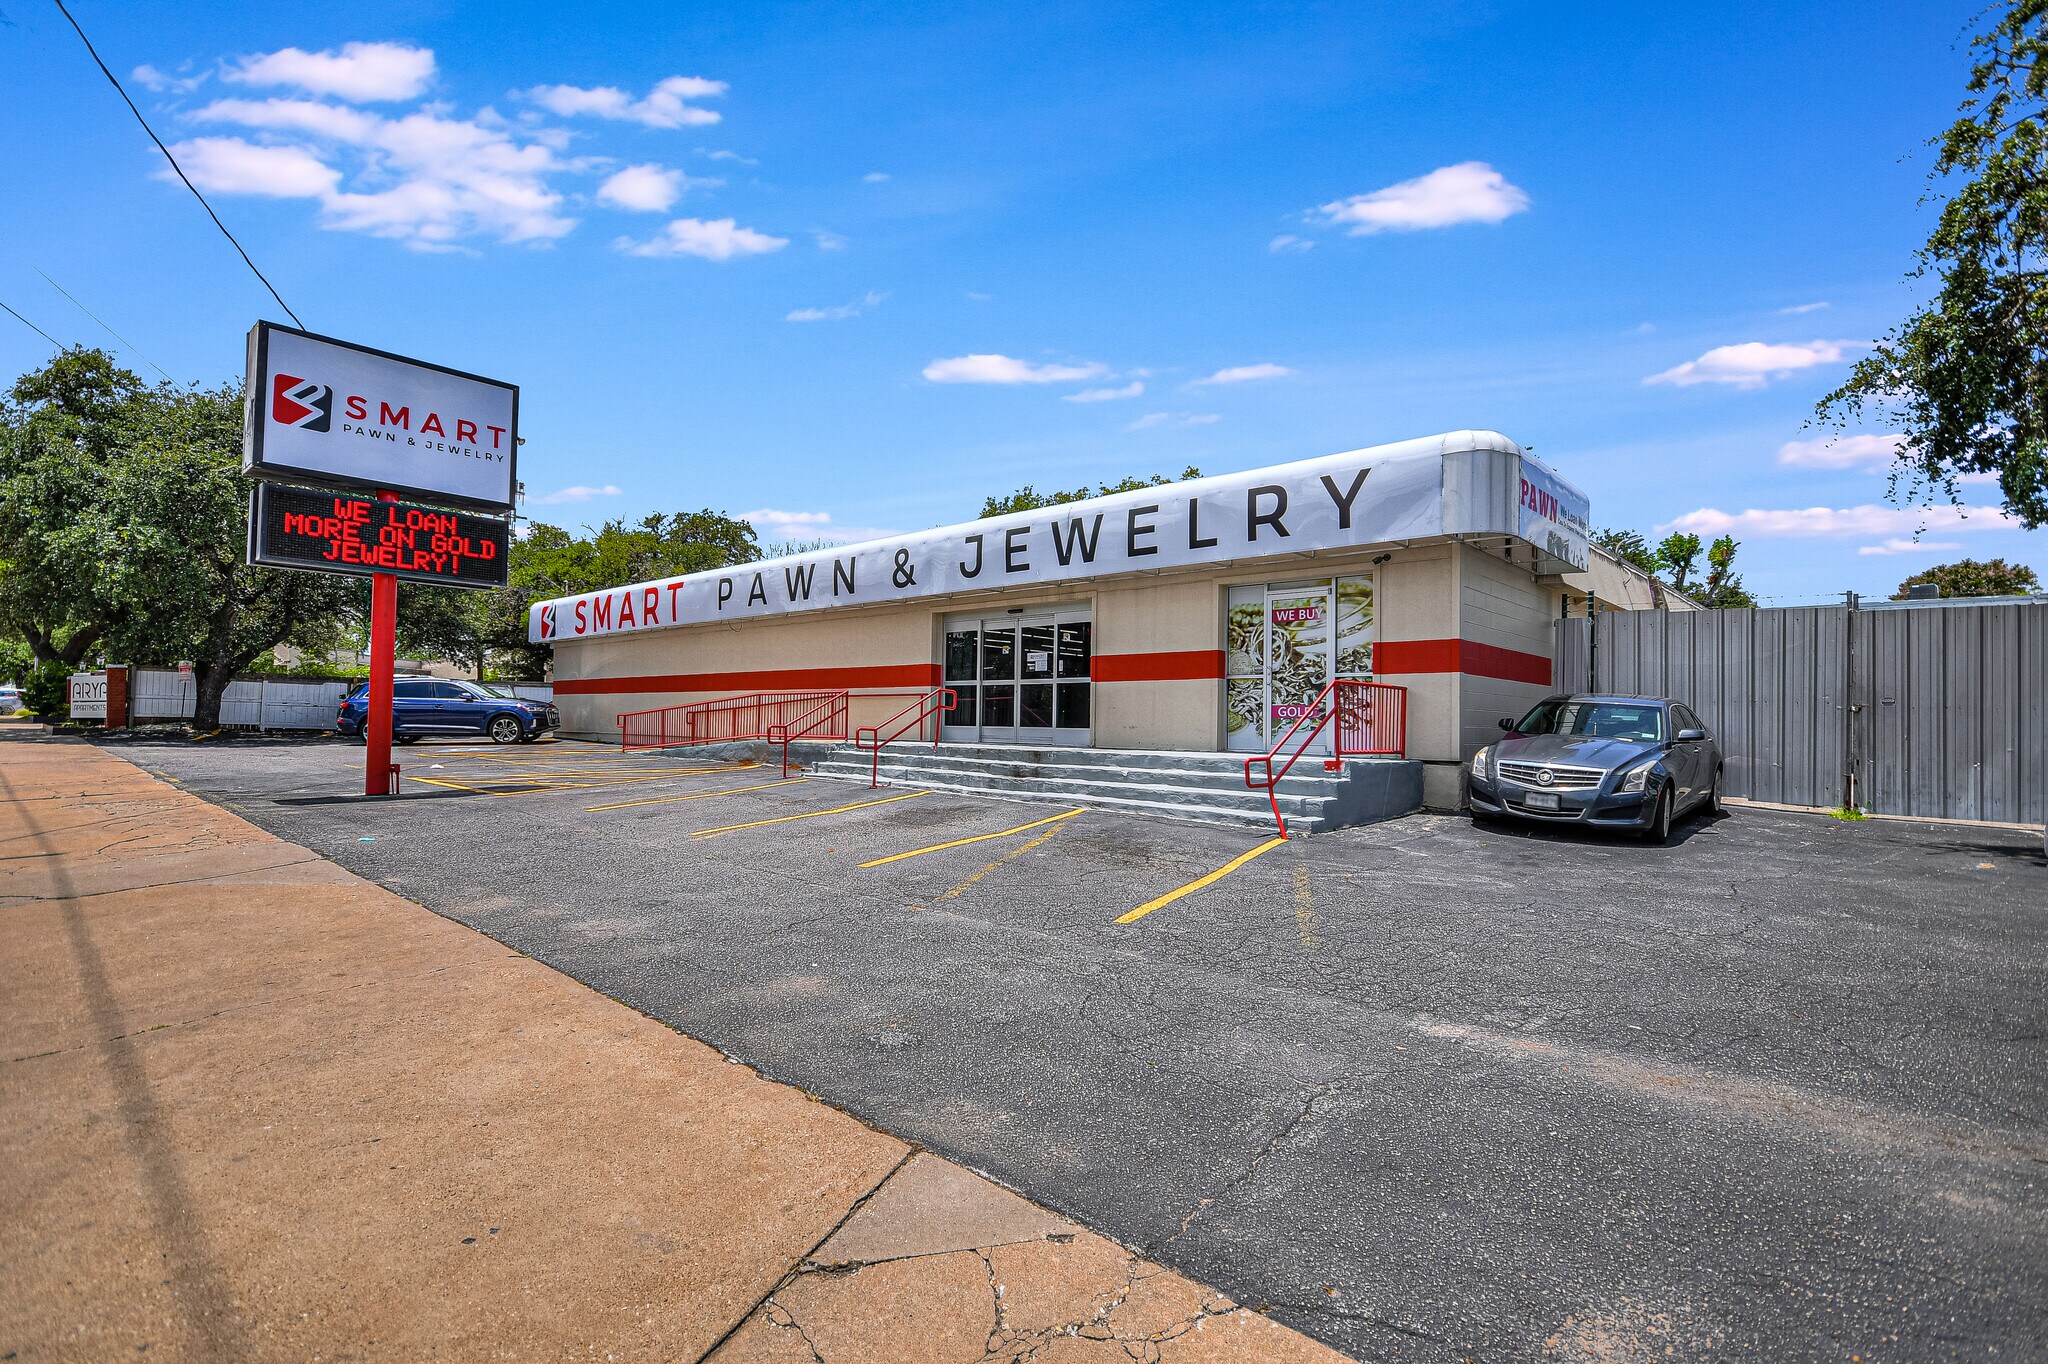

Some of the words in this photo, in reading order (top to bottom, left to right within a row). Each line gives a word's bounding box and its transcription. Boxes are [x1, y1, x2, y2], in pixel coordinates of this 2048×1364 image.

[345, 395, 507, 449] SMART
[343, 423, 396, 442] PAWN
[407, 436, 416, 446] &
[425, 440, 504, 463] JEWELRY
[334, 498, 372, 524] WE
[388, 506, 458, 535] LOAN
[1520, 478, 1559, 524] PAWN
[284, 511, 362, 542] MORE
[379, 526, 415, 549] ON
[431, 533, 497, 561] GOLD
[574, 581, 685, 635] SMART
[717, 556, 857, 611] PAWN
[891, 547, 918, 590] &
[958, 467, 1373, 579] JEWELRY
[322, 539, 460, 576] JEWELRY!
[1276, 610, 1295, 621] WE
[1299, 608, 1323, 620] BUY
[73, 704, 107, 712] APARTMENTS
